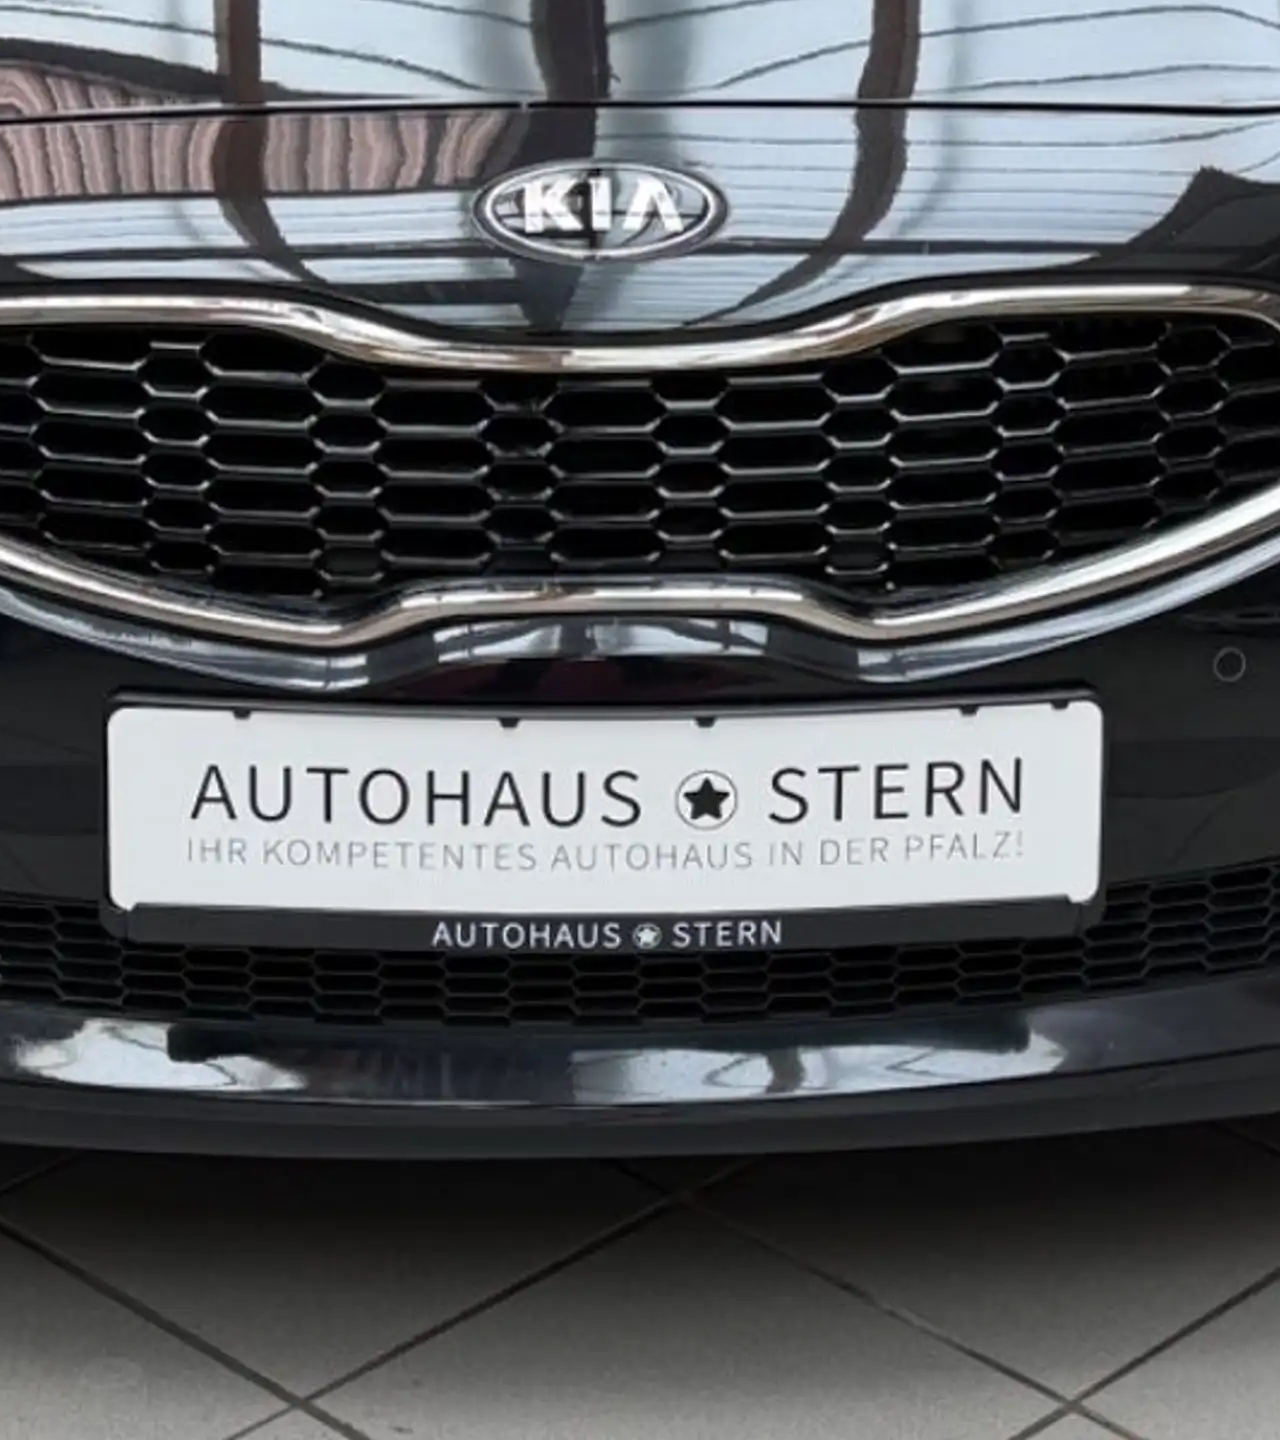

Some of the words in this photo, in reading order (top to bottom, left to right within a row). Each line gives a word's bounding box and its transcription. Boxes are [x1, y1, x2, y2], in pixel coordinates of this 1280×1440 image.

[522, 175, 685, 234] KIA
[190, 764, 642, 828] AUTOHAUS
[768, 756, 1023, 825] STERN
[186, 837, 248, 865] IHR
[262, 839, 537, 872] KOMPETENTES
[551, 841, 753, 872] AUTOHAUS
[767, 839, 804, 867] IN
[820, 836, 888, 867] DER
[904, 829, 1024, 863] PFALZ!
[430, 921, 622, 951] AUTOHAUS
[672, 919, 783, 948] STERN
